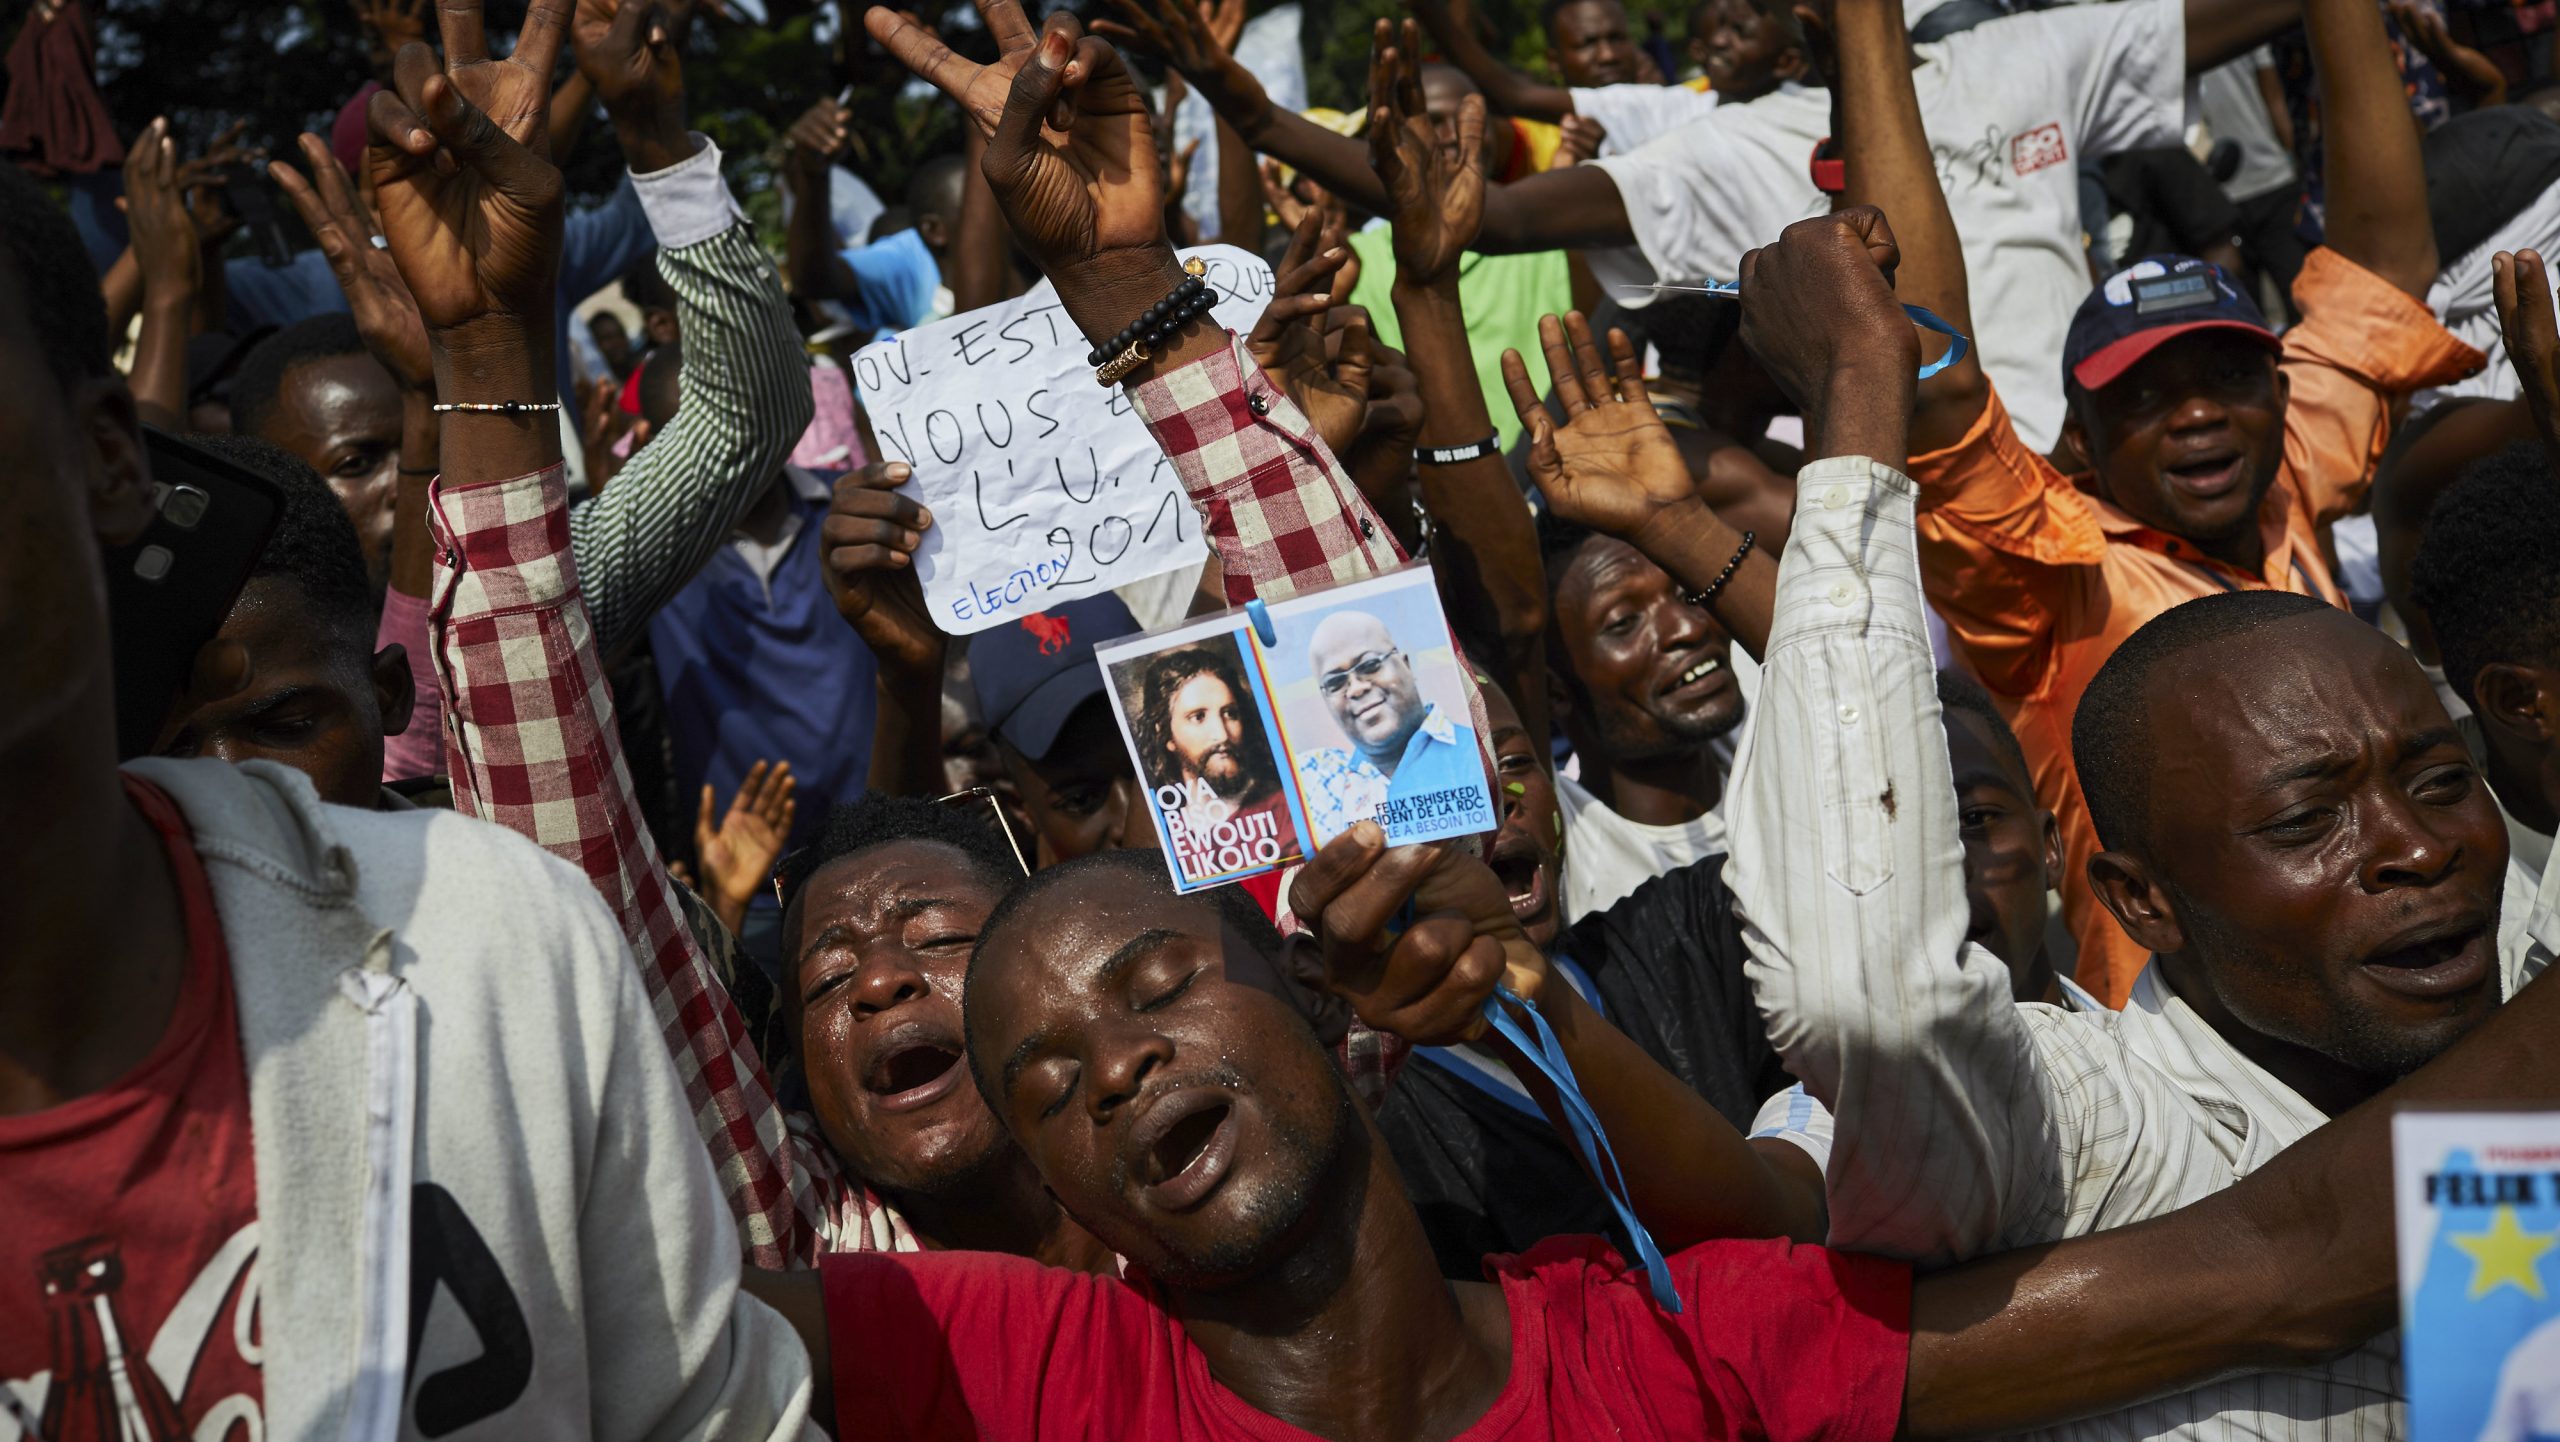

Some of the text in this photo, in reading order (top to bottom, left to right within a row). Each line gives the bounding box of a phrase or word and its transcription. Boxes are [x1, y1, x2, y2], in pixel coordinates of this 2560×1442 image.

[1046, 490, 1185, 591] 201
[1156, 777, 1219, 811] OYA
[1375, 784, 1480, 814] FELIX TSHISEKEDI
[1418, 806, 1434, 819] DE
[1436, 803, 1454, 816] LA
[1456, 796, 1486, 811] RDC
[1164, 798, 1229, 834] BISO
[1170, 810, 1278, 857] EWOUTI
[1404, 823, 1414, 836] A
[1416, 815, 1463, 834] BESOIN
[1465, 809, 1489, 824] TOI
[1180, 837, 1280, 879] LIKOLO
